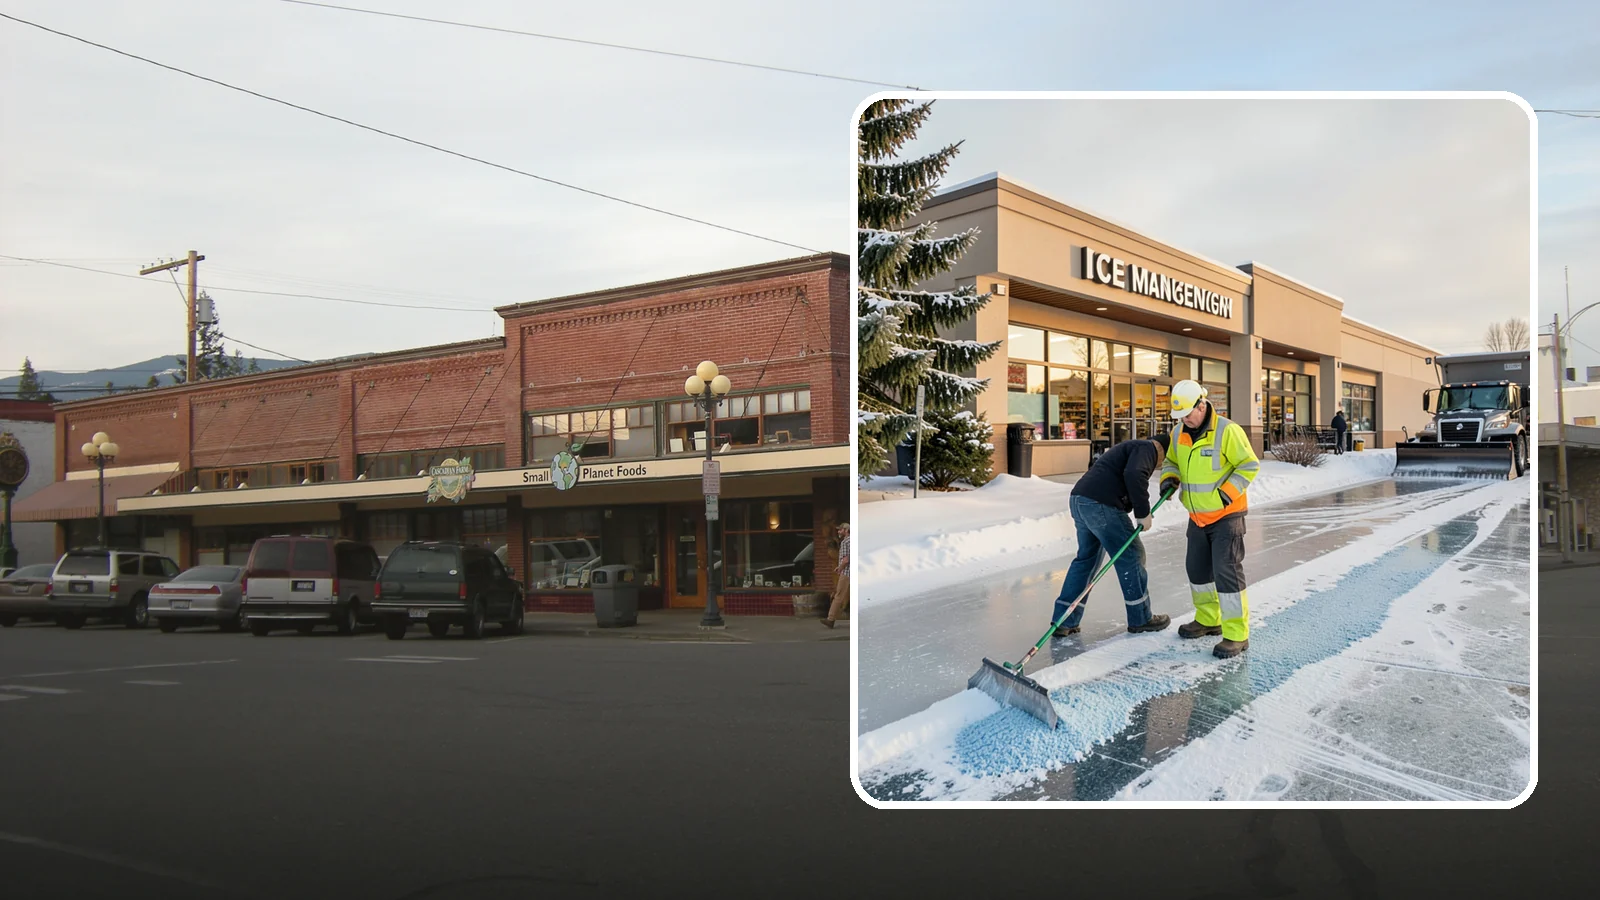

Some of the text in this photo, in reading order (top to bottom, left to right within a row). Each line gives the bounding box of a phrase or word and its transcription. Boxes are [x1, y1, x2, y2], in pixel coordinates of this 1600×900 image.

[1083, 247, 1126, 289] ICE
[523, 464, 647, 483] Small Planet Foods
